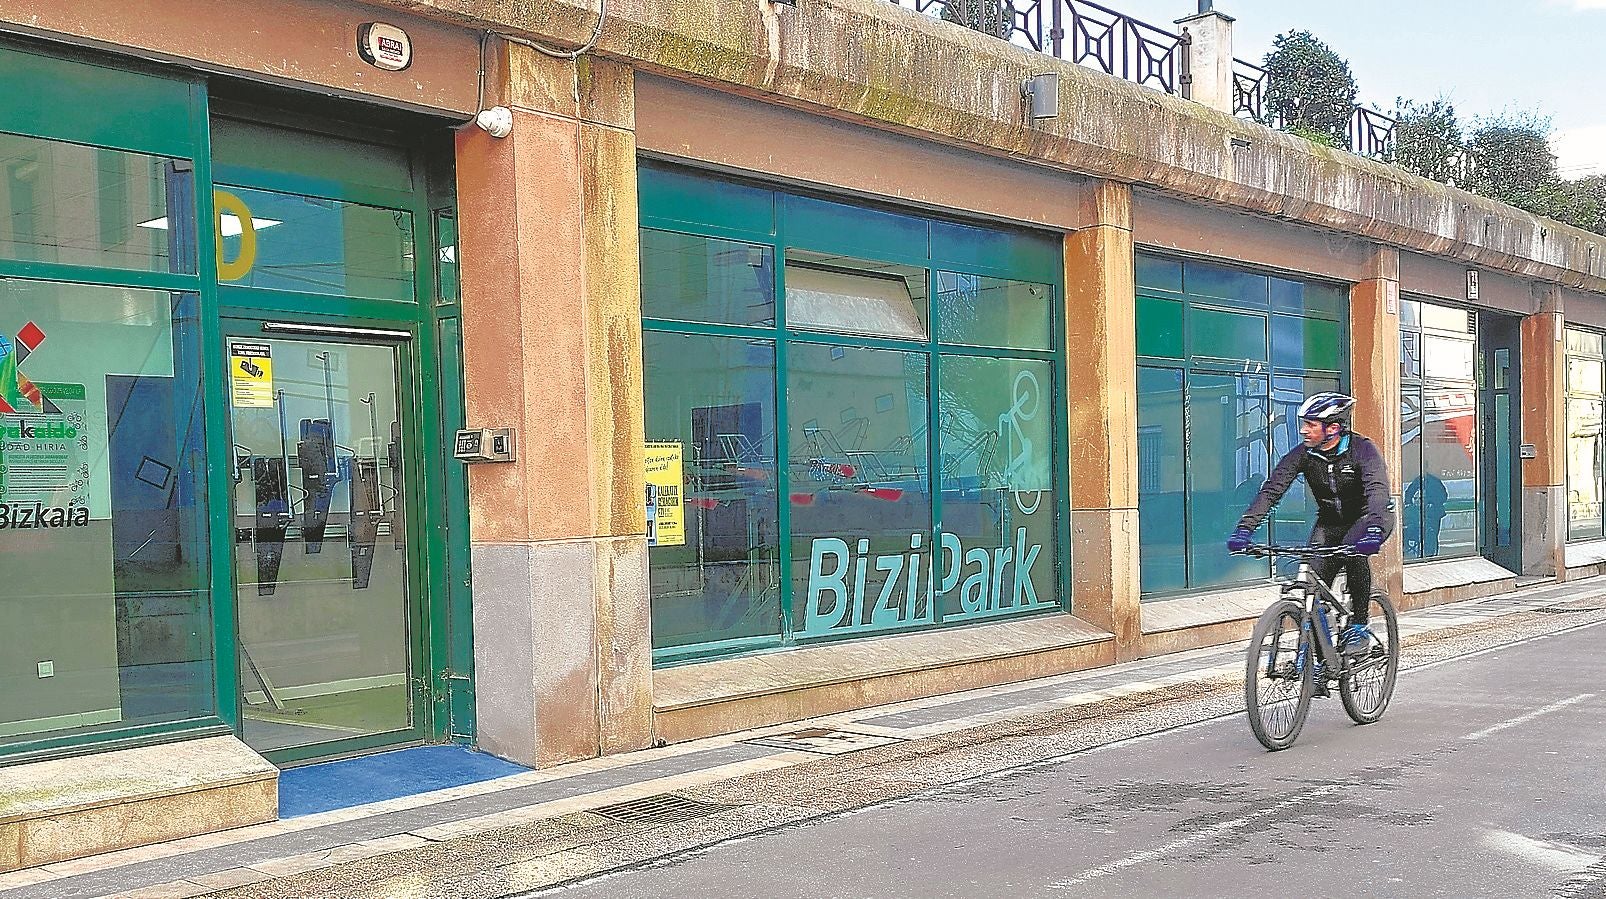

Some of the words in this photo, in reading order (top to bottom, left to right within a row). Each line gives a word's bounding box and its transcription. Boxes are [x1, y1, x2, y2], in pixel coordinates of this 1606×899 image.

[214, 190, 256, 281] D
[36, 443, 66, 451] HIRIA
[0, 502, 89, 529] Bizkaia
